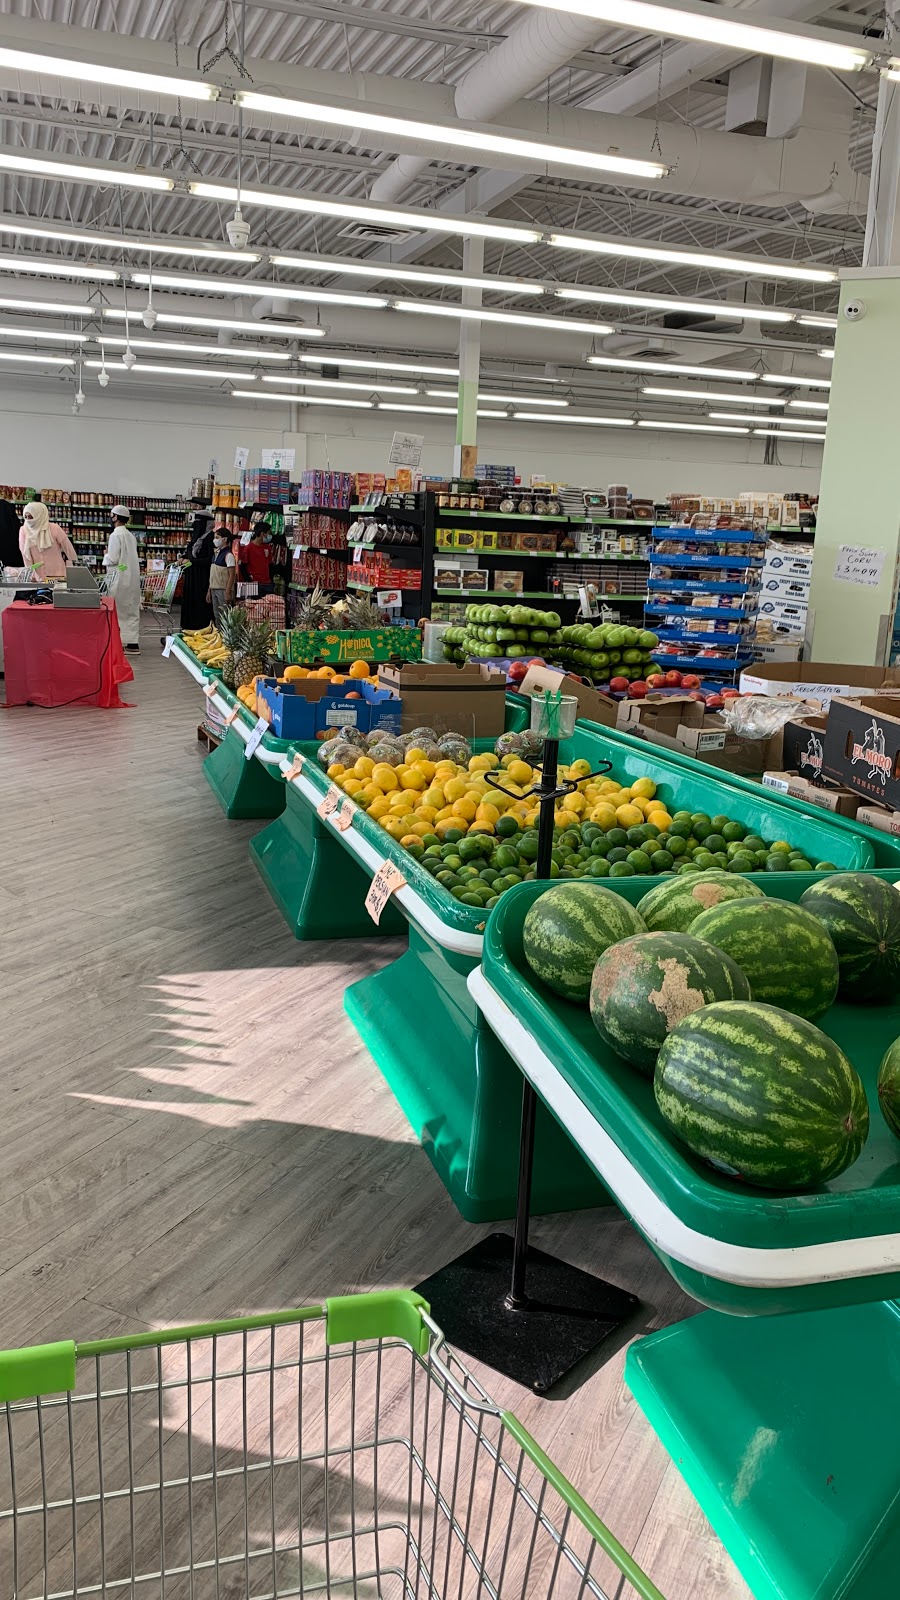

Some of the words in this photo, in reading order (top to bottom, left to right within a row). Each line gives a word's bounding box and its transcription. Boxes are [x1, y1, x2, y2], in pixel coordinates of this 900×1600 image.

[274, 460, 280, 468] 3
[847, 555, 871, 564] CORN
[843, 565, 850, 573] 3
[801, 752, 809, 763] EL
[853, 743, 864, 759] EL
[865, 749, 892, 771] MORO
[852, 776, 885, 796] TOMATES
